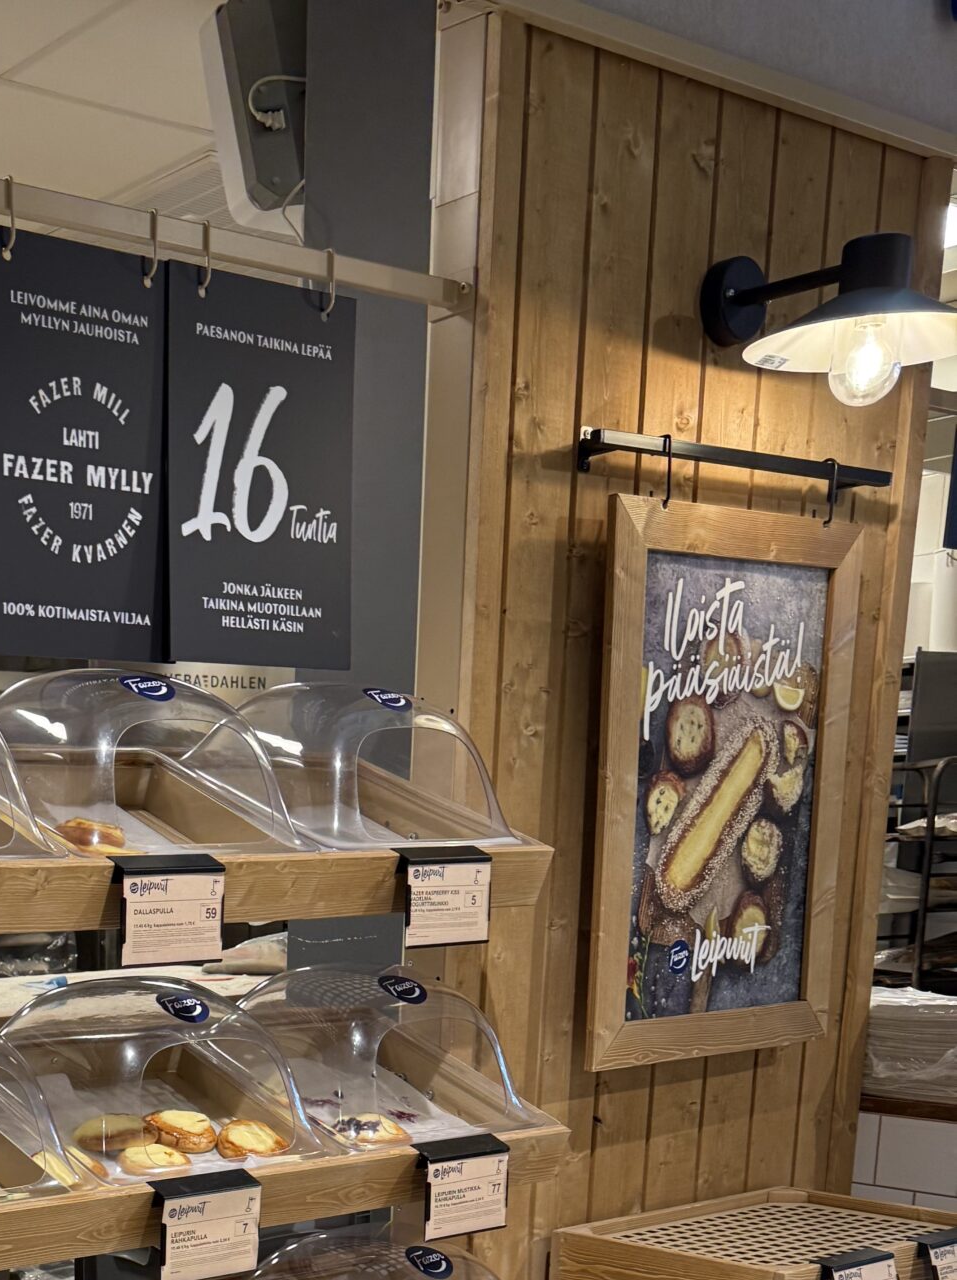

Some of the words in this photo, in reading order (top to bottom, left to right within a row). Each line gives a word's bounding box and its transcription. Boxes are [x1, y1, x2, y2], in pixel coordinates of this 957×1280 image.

[10, 289, 77, 317] LEIVOMME
[78, 303, 109, 320] AINA
[111, 309, 149, 328] OMAN
[21, 313, 70, 333] MYLLYN
[73, 322, 139, 345] JAUHOISTA
[196, 323, 255, 346] PAESANON
[257, 334, 299, 355] TAIKINA
[301, 341, 332, 361] LEPÄÄ
[28, 376, 82, 414] FAZER
[93, 382, 131, 425] MILL
[63, 427, 99, 450] LAHTI
[181, 383, 289, 543] 16
[3, 453, 73, 485] FAZER
[86, 464, 153, 494] MYLLY
[69, 502, 93, 520] 1971
[18, 494, 62, 556] FAZER
[72, 507, 143, 564] KVARNEN
[289, 504, 338, 544] Tuntia
[222, 582, 258, 598] JONKA
[259, 583, 302, 600] JÄLKEEN
[2, 602, 35, 617] 100%
[38, 604, 109, 623] KOTIMAISTA
[110, 609, 151, 626] VILJAA
[202, 597, 245, 613] TAIKINA
[246, 600, 322, 618] MUOTOILLAAN
[222, 615, 269, 631] HELLÄSTI
[270, 617, 304, 633] KÄSIN
[664, 577, 745, 661] Iloista
[124, 678, 166, 693] Fazer
[211, 675, 267, 690] DAHLEN
[643, 621, 805, 741] pääsiäistä!
[367, 690, 403, 704] Fazer
[140, 879, 174, 896] Leipurit
[471, 895, 477, 905] 5
[205, 907, 217, 919] 59
[691, 922, 771, 982] Leipurit
[382, 979, 418, 997] Fazer
[161, 996, 200, 1015] Fazer
[492, 1183, 501, 1193] 77
[178, 1201, 211, 1220] Leipurit
[170, 1230, 196, 1239] LEIPURIN
[242, 1223, 248, 1233] 7
[170, 1234, 208, 1245] RAHKAPULLA
[410, 1250, 445, 1271] Fazer
